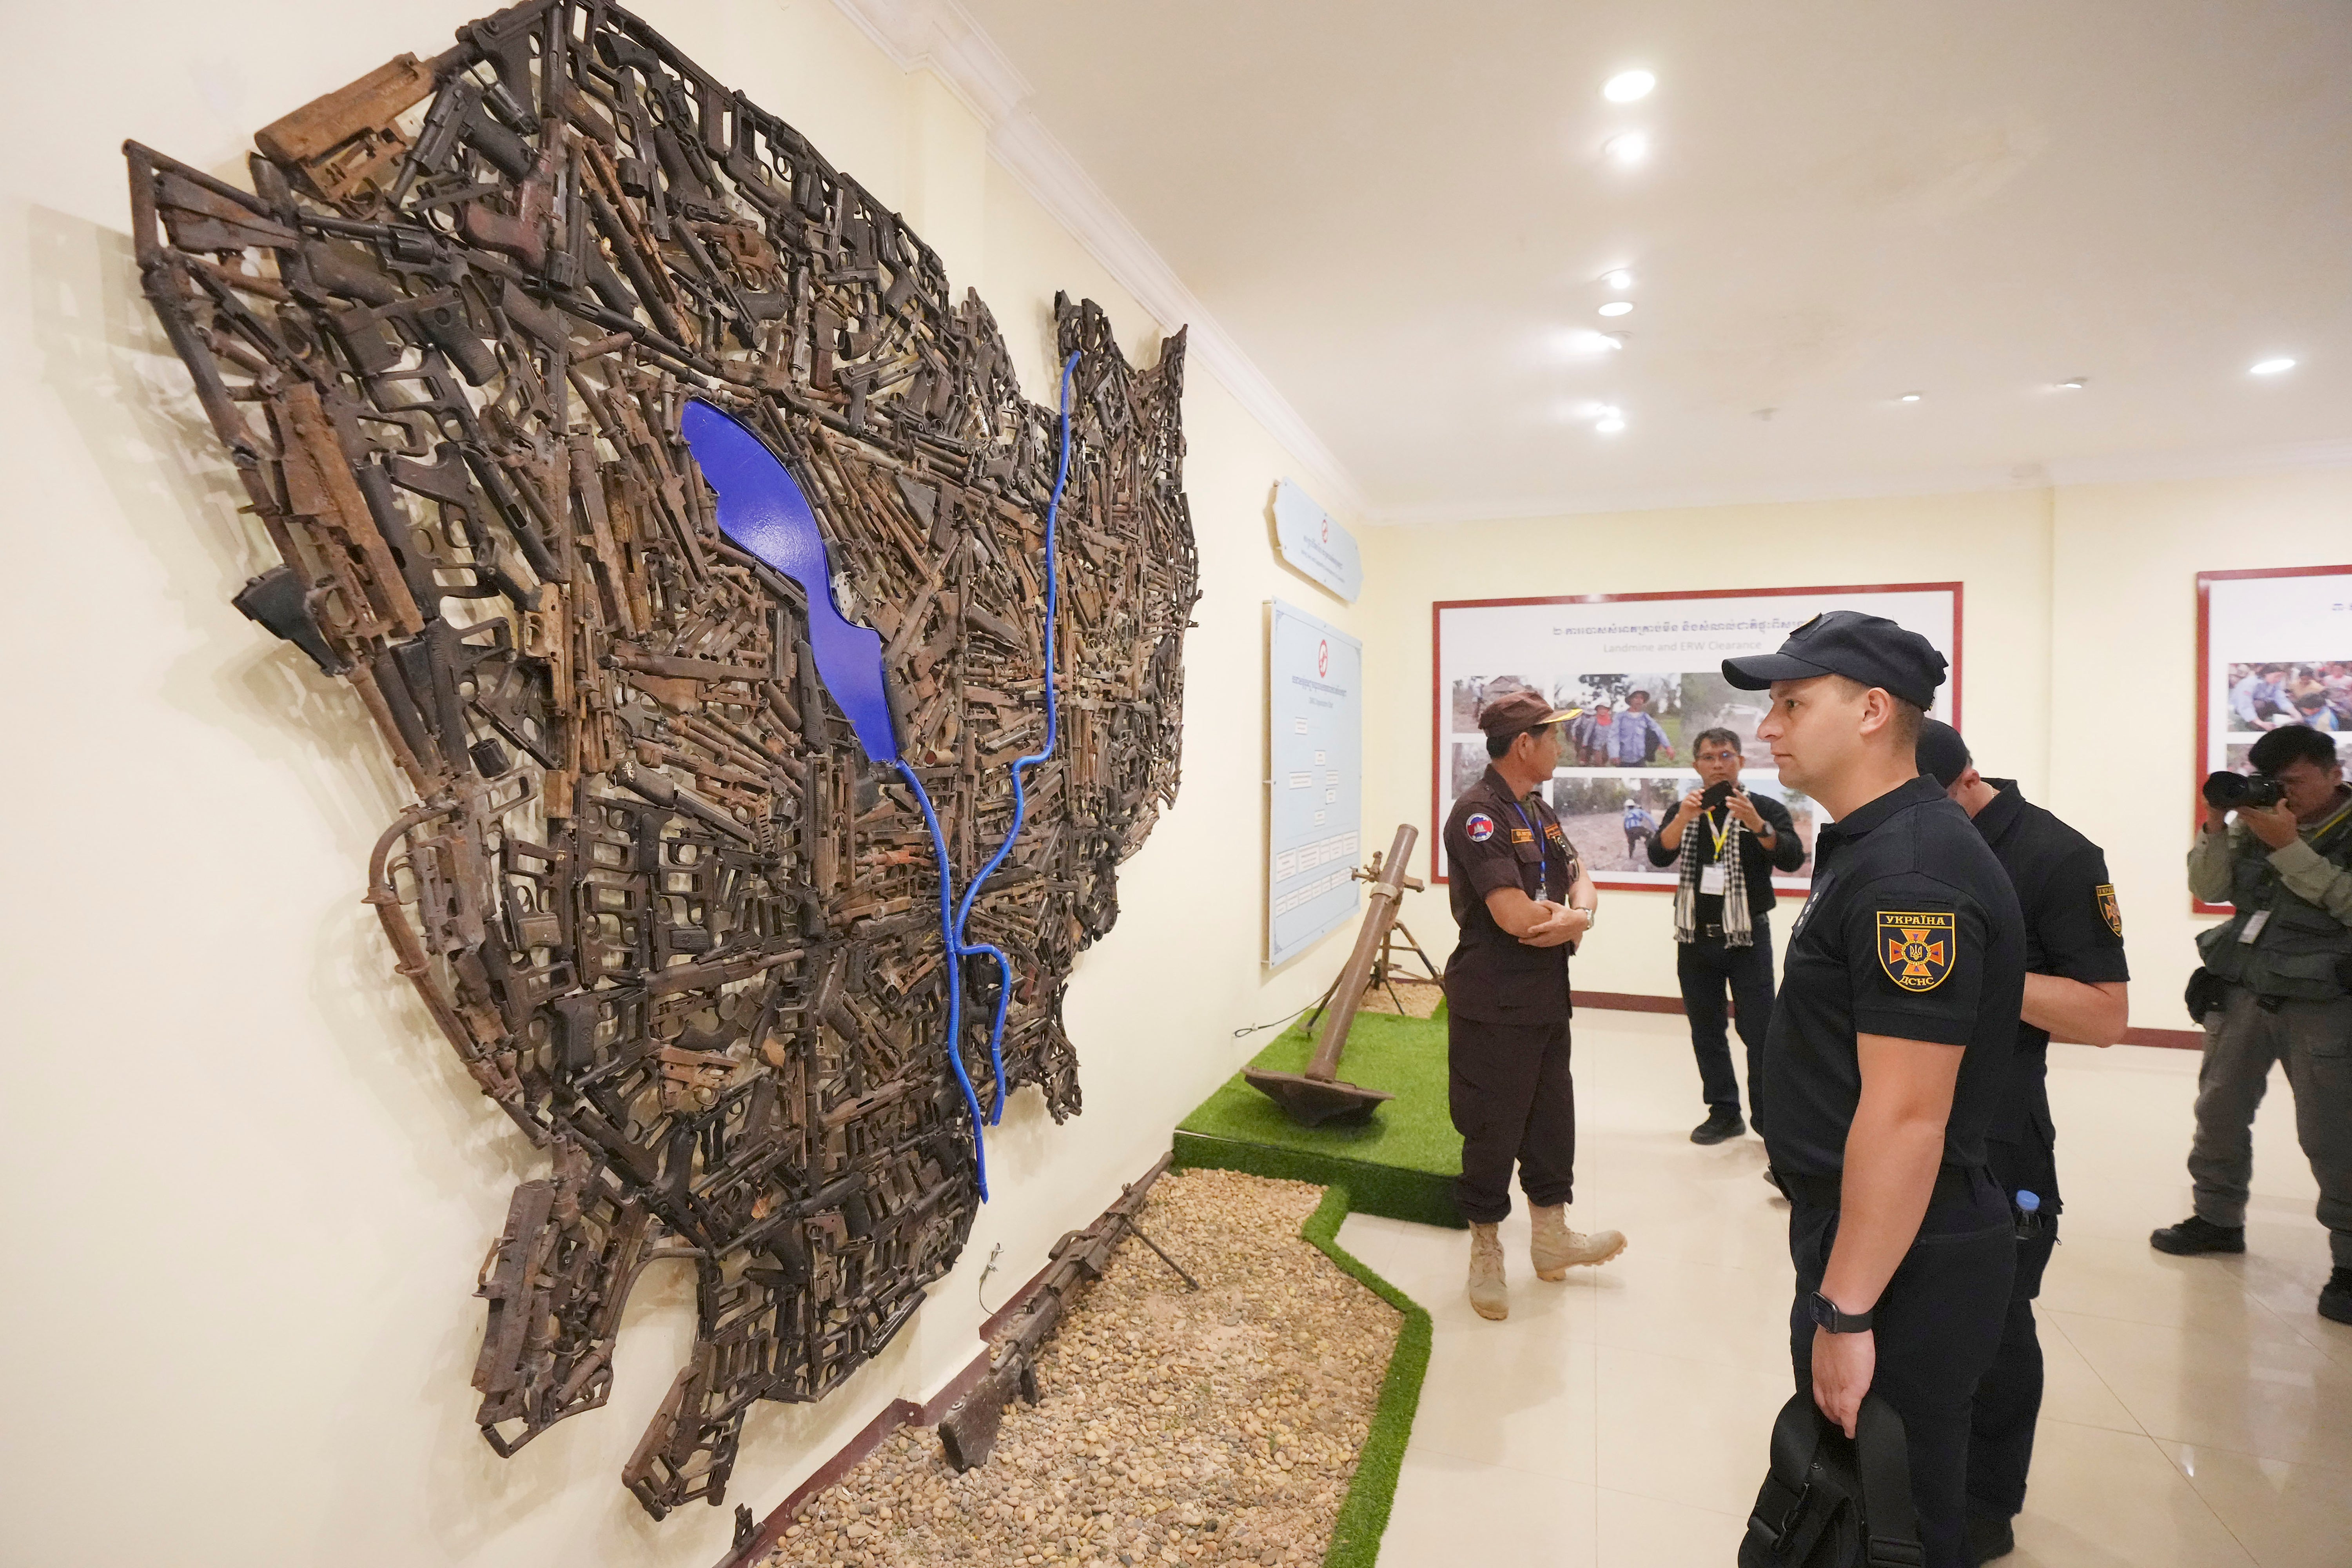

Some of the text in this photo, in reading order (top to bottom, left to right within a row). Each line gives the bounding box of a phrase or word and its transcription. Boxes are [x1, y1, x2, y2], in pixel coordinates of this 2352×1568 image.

[1603, 640, 1762, 653] Landmine and ERW Clearance
[1886, 915, 1945, 926] УКРАЇНА
[1899, 975, 1935, 986] ДСНС
